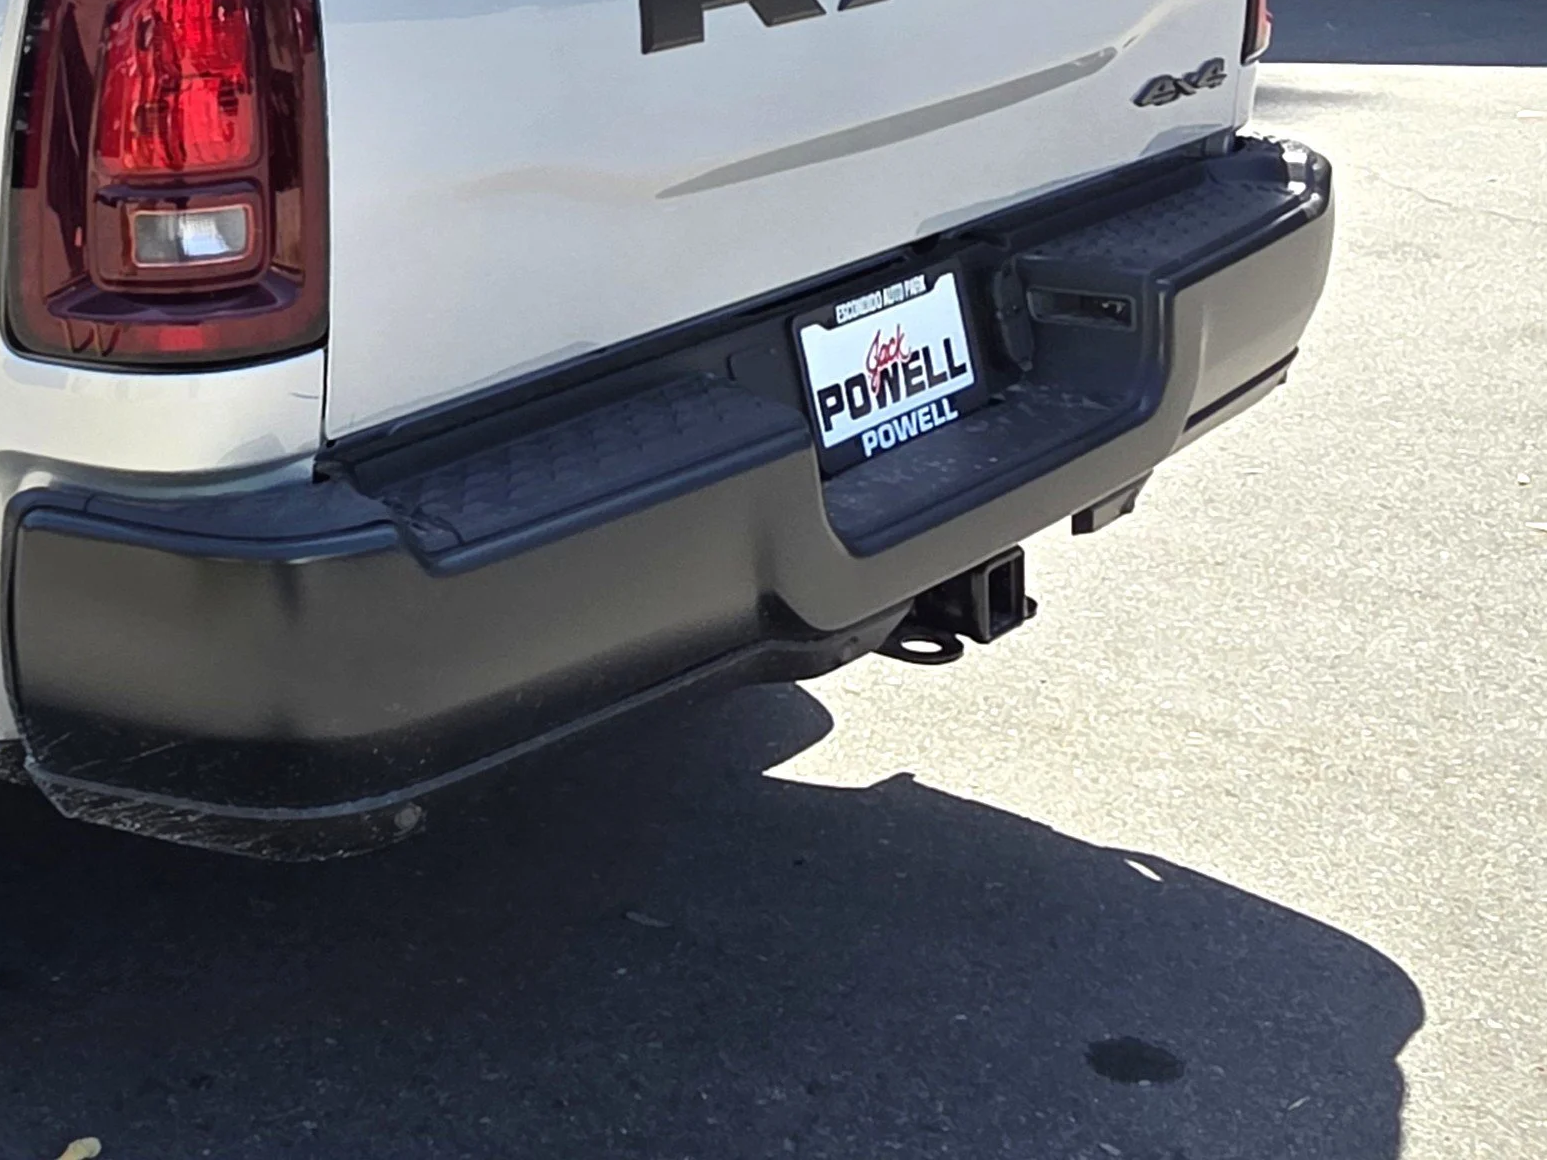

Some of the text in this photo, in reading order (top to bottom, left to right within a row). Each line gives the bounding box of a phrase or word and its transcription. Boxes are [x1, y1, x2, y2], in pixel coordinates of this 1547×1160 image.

[816, 337, 967, 433] POWELL
[865, 323, 911, 394] Jack
[861, 396, 959, 458] POWELL
